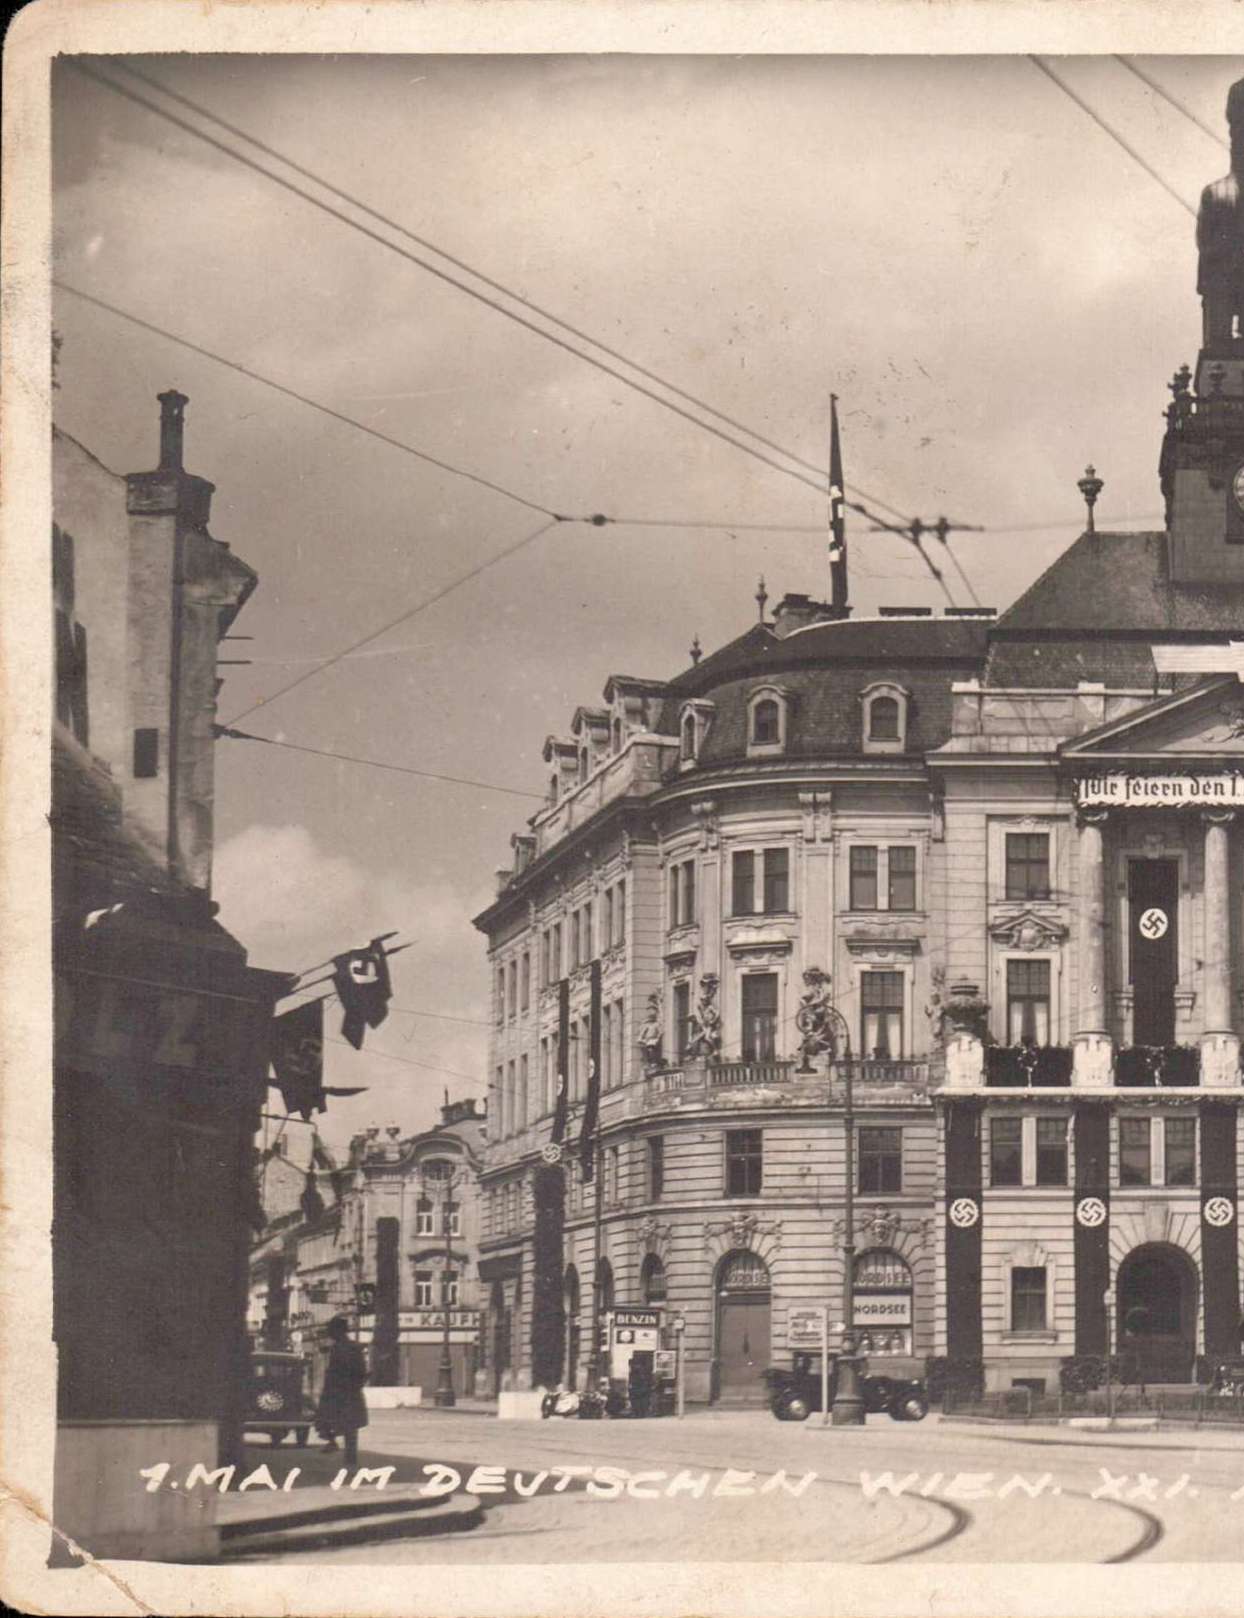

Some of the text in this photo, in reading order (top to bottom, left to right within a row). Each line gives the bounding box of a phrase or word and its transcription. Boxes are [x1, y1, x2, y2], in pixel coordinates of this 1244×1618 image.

[1085, 777, 1118, 799] Wir
[1126, 775, 1183, 800] feiern
[1190, 776, 1225, 797] den
[855, 1303, 907, 1315] NORDSEE
[616, 1313, 657, 1325] BENZIN
